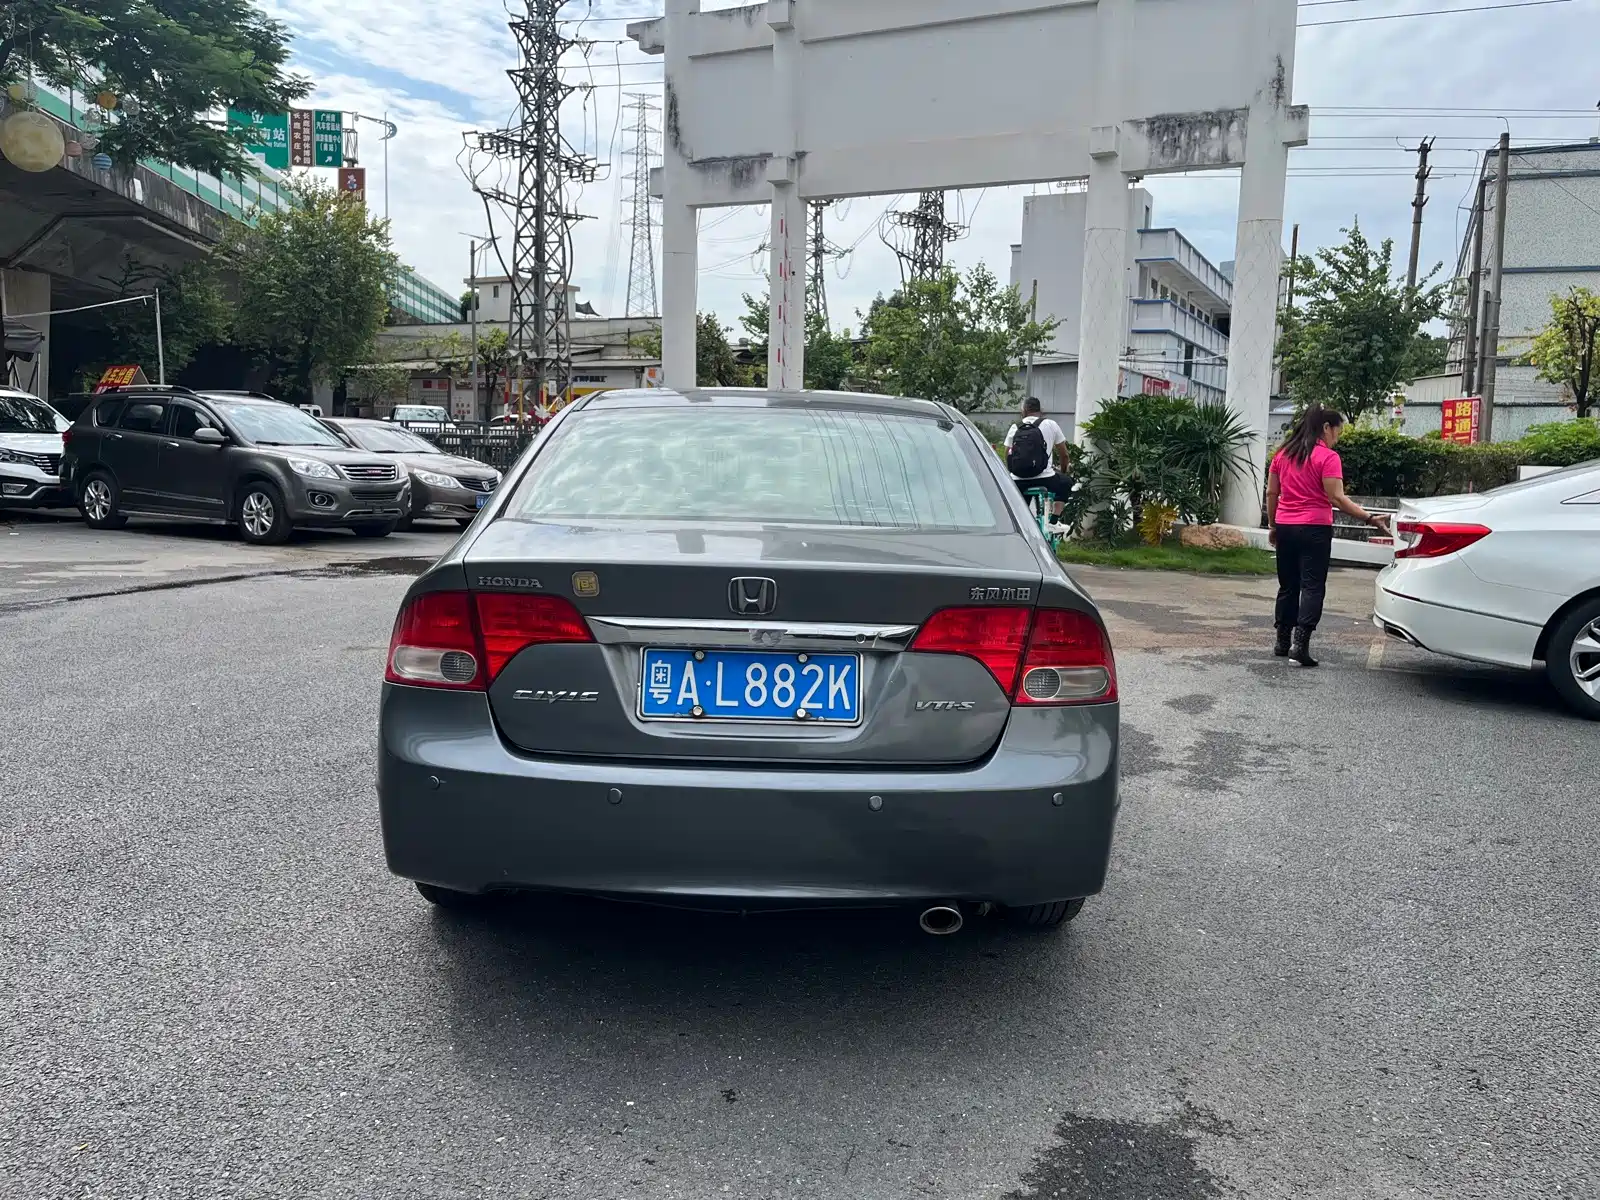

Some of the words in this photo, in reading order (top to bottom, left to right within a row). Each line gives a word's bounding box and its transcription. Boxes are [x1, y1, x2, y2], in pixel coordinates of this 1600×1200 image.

[478, 576, 543, 589] HONDA
[970, 586, 1031, 601] 东风本田
[512, 689, 600, 704] CIVIC
